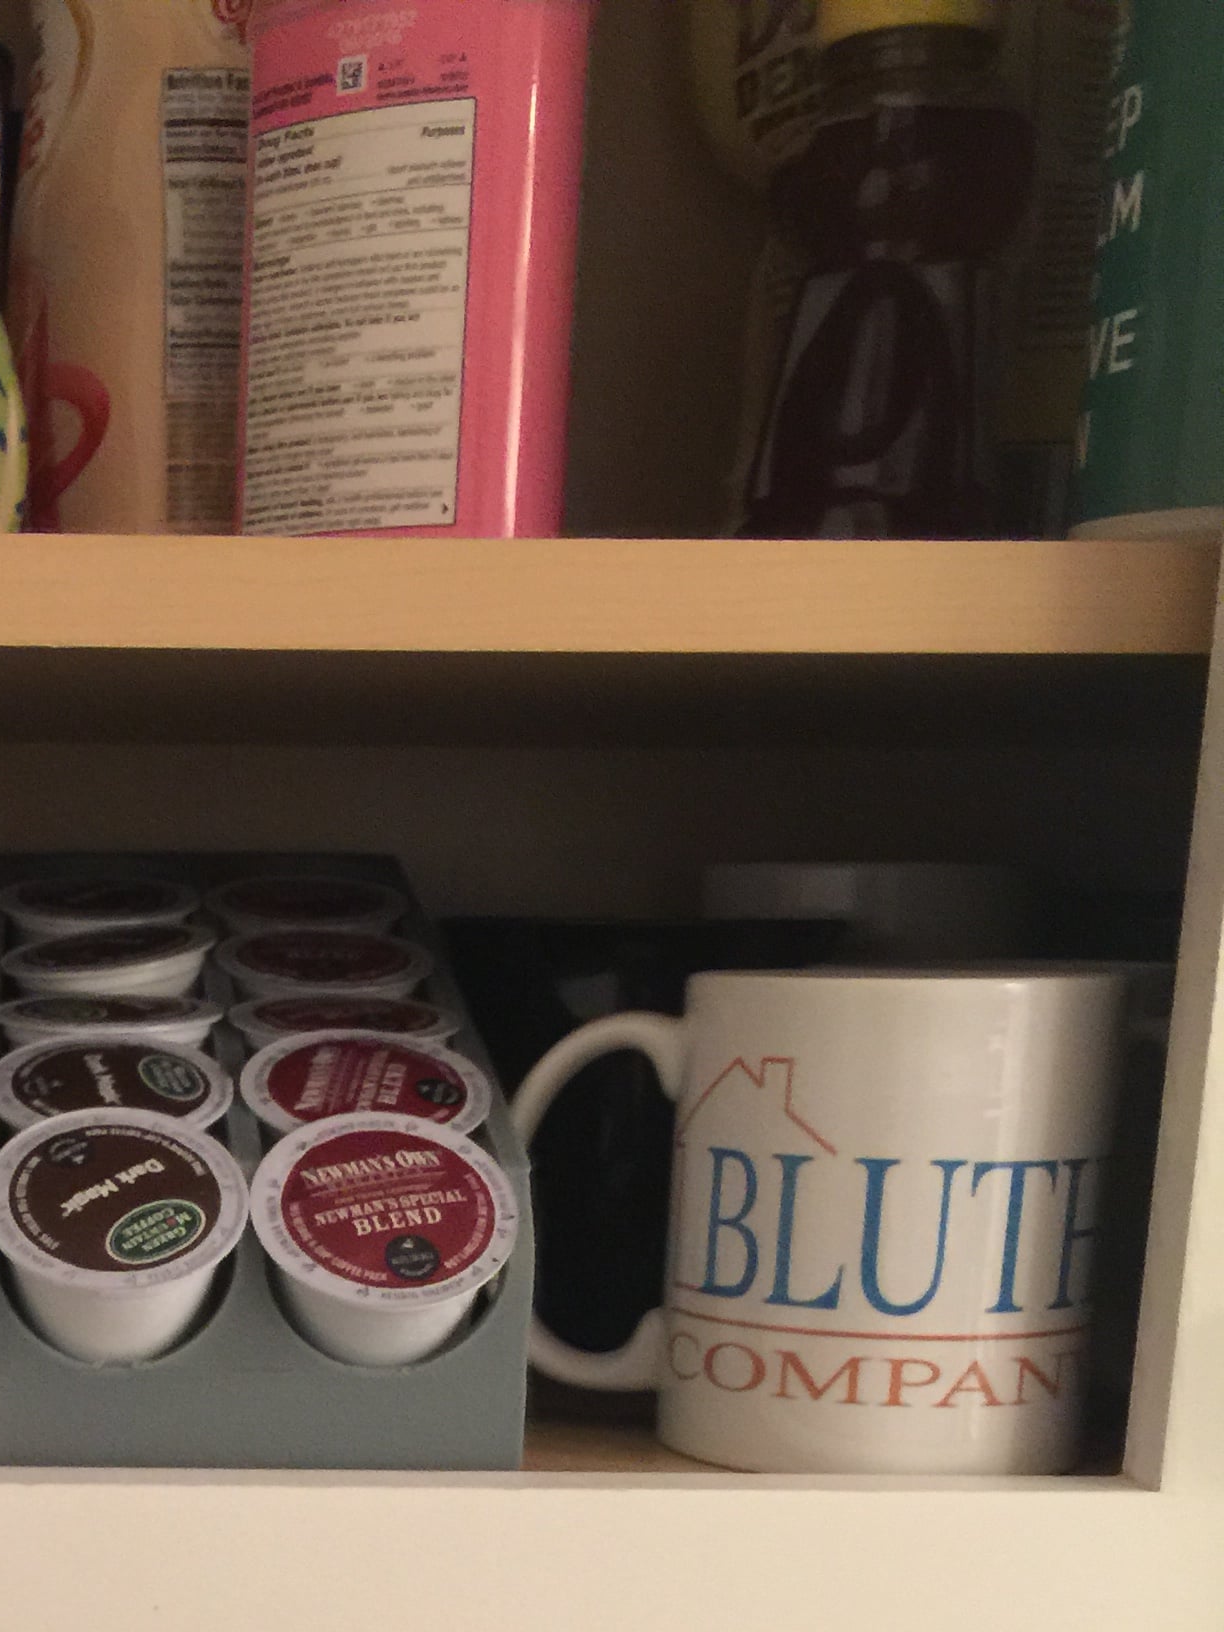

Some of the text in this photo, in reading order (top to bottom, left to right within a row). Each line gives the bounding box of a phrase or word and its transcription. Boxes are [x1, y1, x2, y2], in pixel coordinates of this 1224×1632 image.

[299, 1152, 397, 1188] NEWMAN'S
[395, 1149, 441, 1169] OWN
[314, 1197, 398, 1228] NEWMAN'S
[398, 1188, 468, 1211] SPECIAL
[351, 1206, 443, 1237] BLEND
[697, 1145, 1104, 1318] BLUTH
[668, 1331, 1079, 1410] COMPAN
